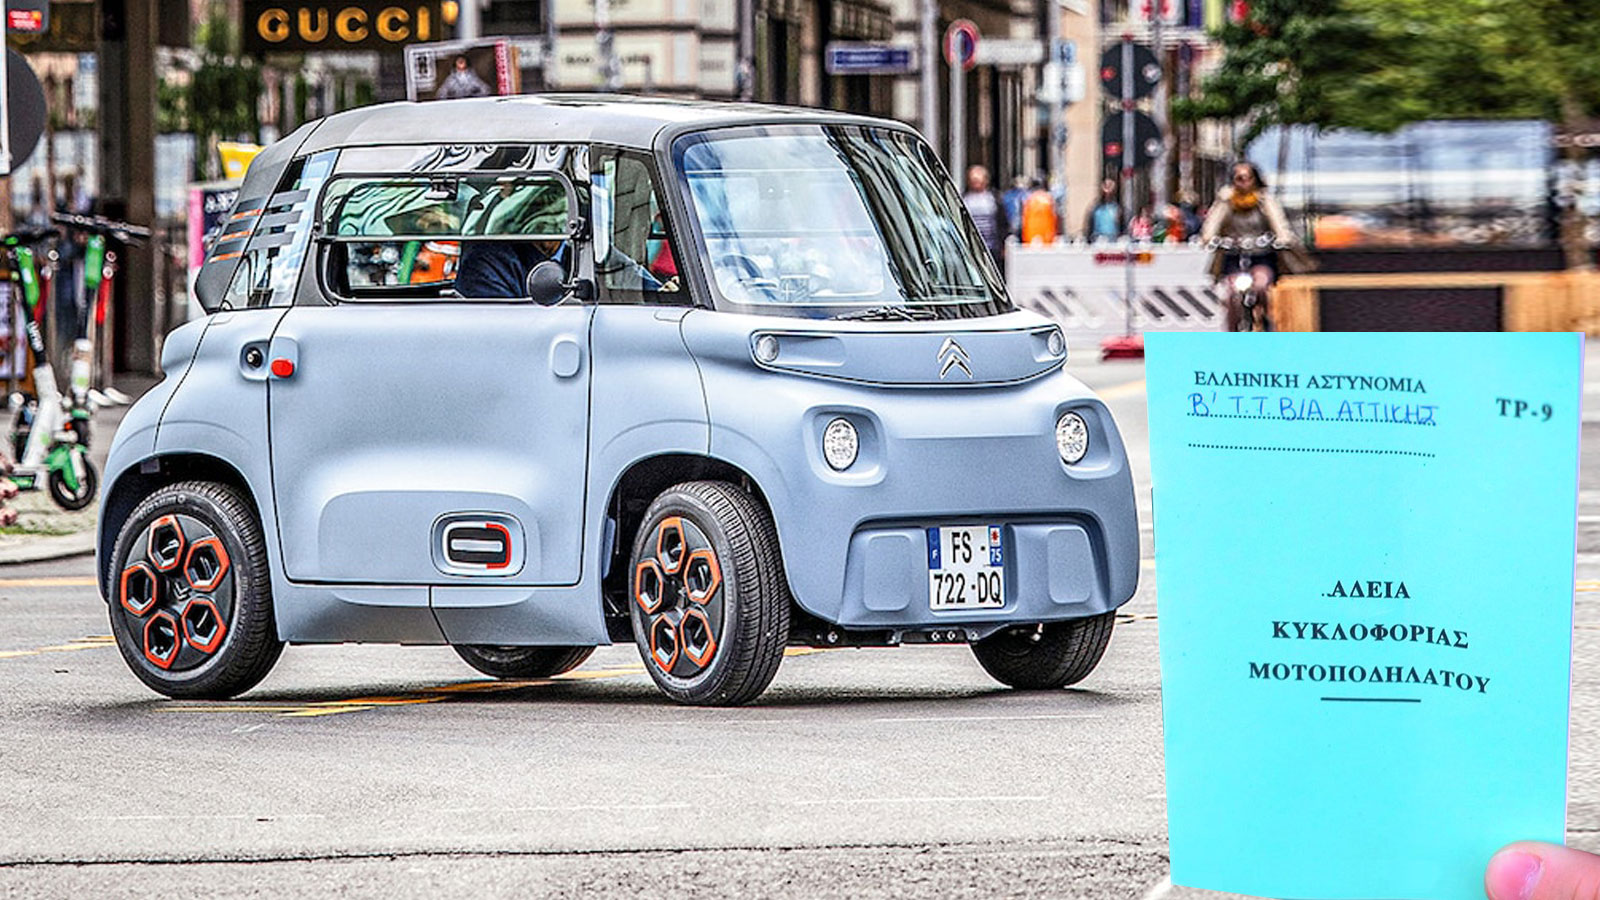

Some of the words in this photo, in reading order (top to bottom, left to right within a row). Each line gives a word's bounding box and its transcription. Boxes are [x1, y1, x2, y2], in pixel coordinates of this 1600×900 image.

[257, 6, 431, 43] GUCCI
[1194, 370, 1299, 389] ΕΛΛΗΝΙΚΗ
[1306, 374, 1427, 394] ΑΣΤΥΝΟΜΙΑ
[1338, 399, 1439, 426] ΑΤΤΙΚΗΣ
[932, 549, 938, 560] F
[990, 548, 1002, 563] 75
[1330, 580, 1411, 599] ΑΔΕΙΑ
[1271, 620, 1469, 649] ΚΥΚΛΟΦΟΡΙΑΣ
[1248, 661, 1491, 694] ΜΟΤΟΠΟΔΗΛΑΤΟΥ
